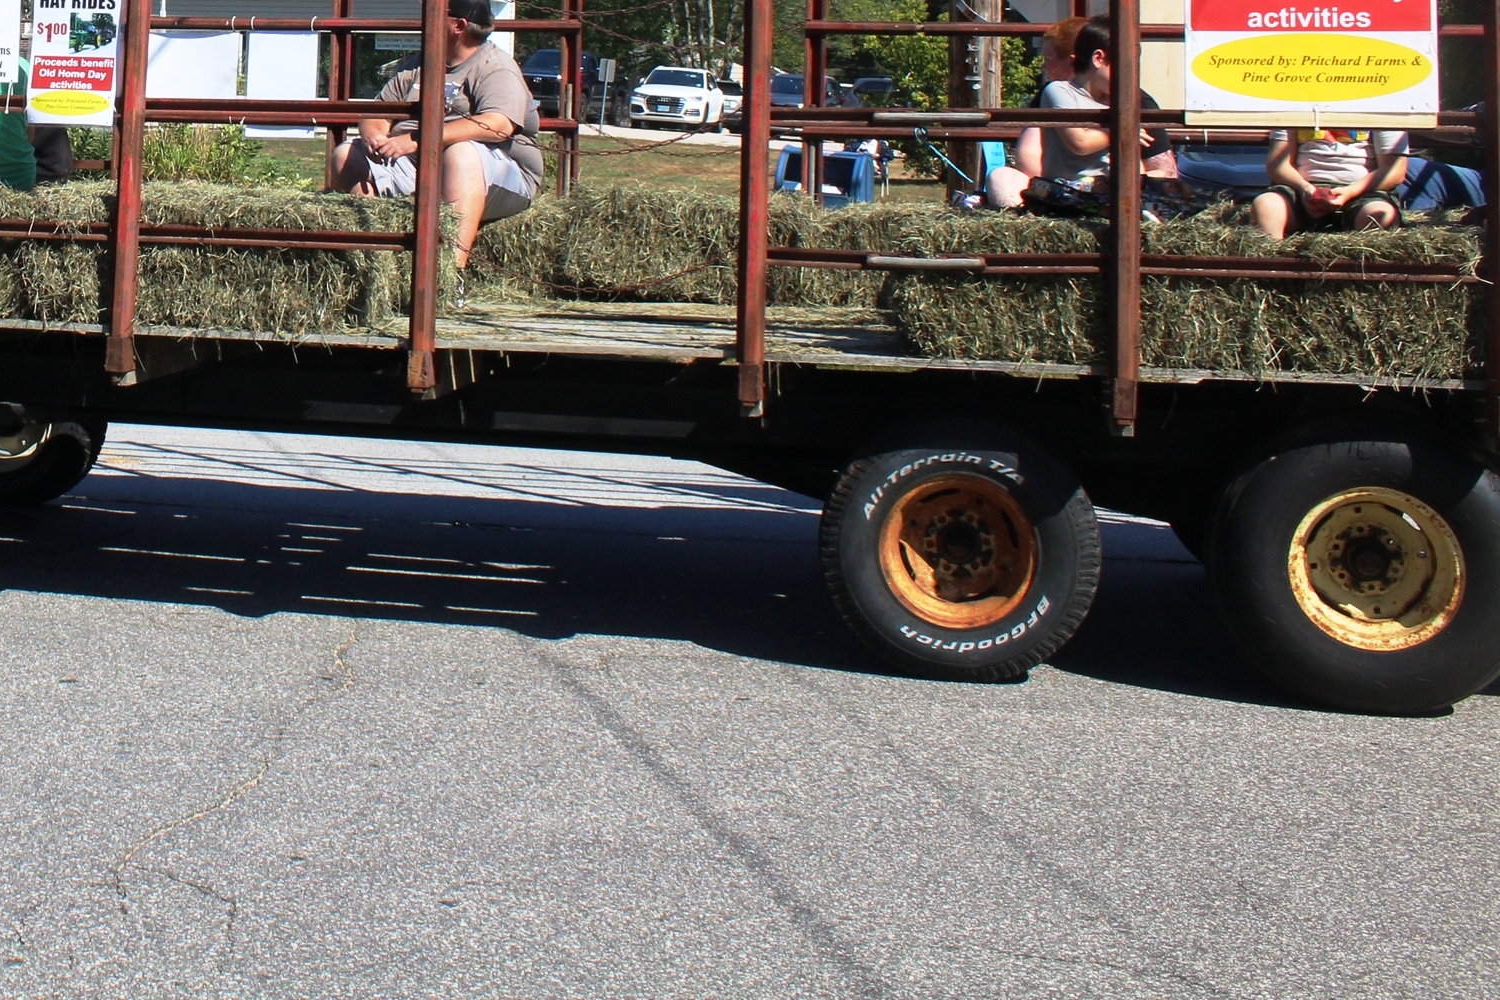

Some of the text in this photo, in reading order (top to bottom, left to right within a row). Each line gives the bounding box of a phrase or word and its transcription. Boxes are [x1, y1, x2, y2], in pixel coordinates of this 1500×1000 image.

[1247, 6, 1371, 28] activities
[34, 56, 114, 68] Proceeds benefit
[1209, 55, 1422, 68] Sponsored by: Pritchard Farms &
[39, 68, 107, 81] Old Home Day
[1242, 72, 1390, 86] Pine Grove Community
[50, 80, 93, 90] activities
[863, 452, 982, 521] All-Terrain
[900, 595, 1050, 654] BFGoodrich
